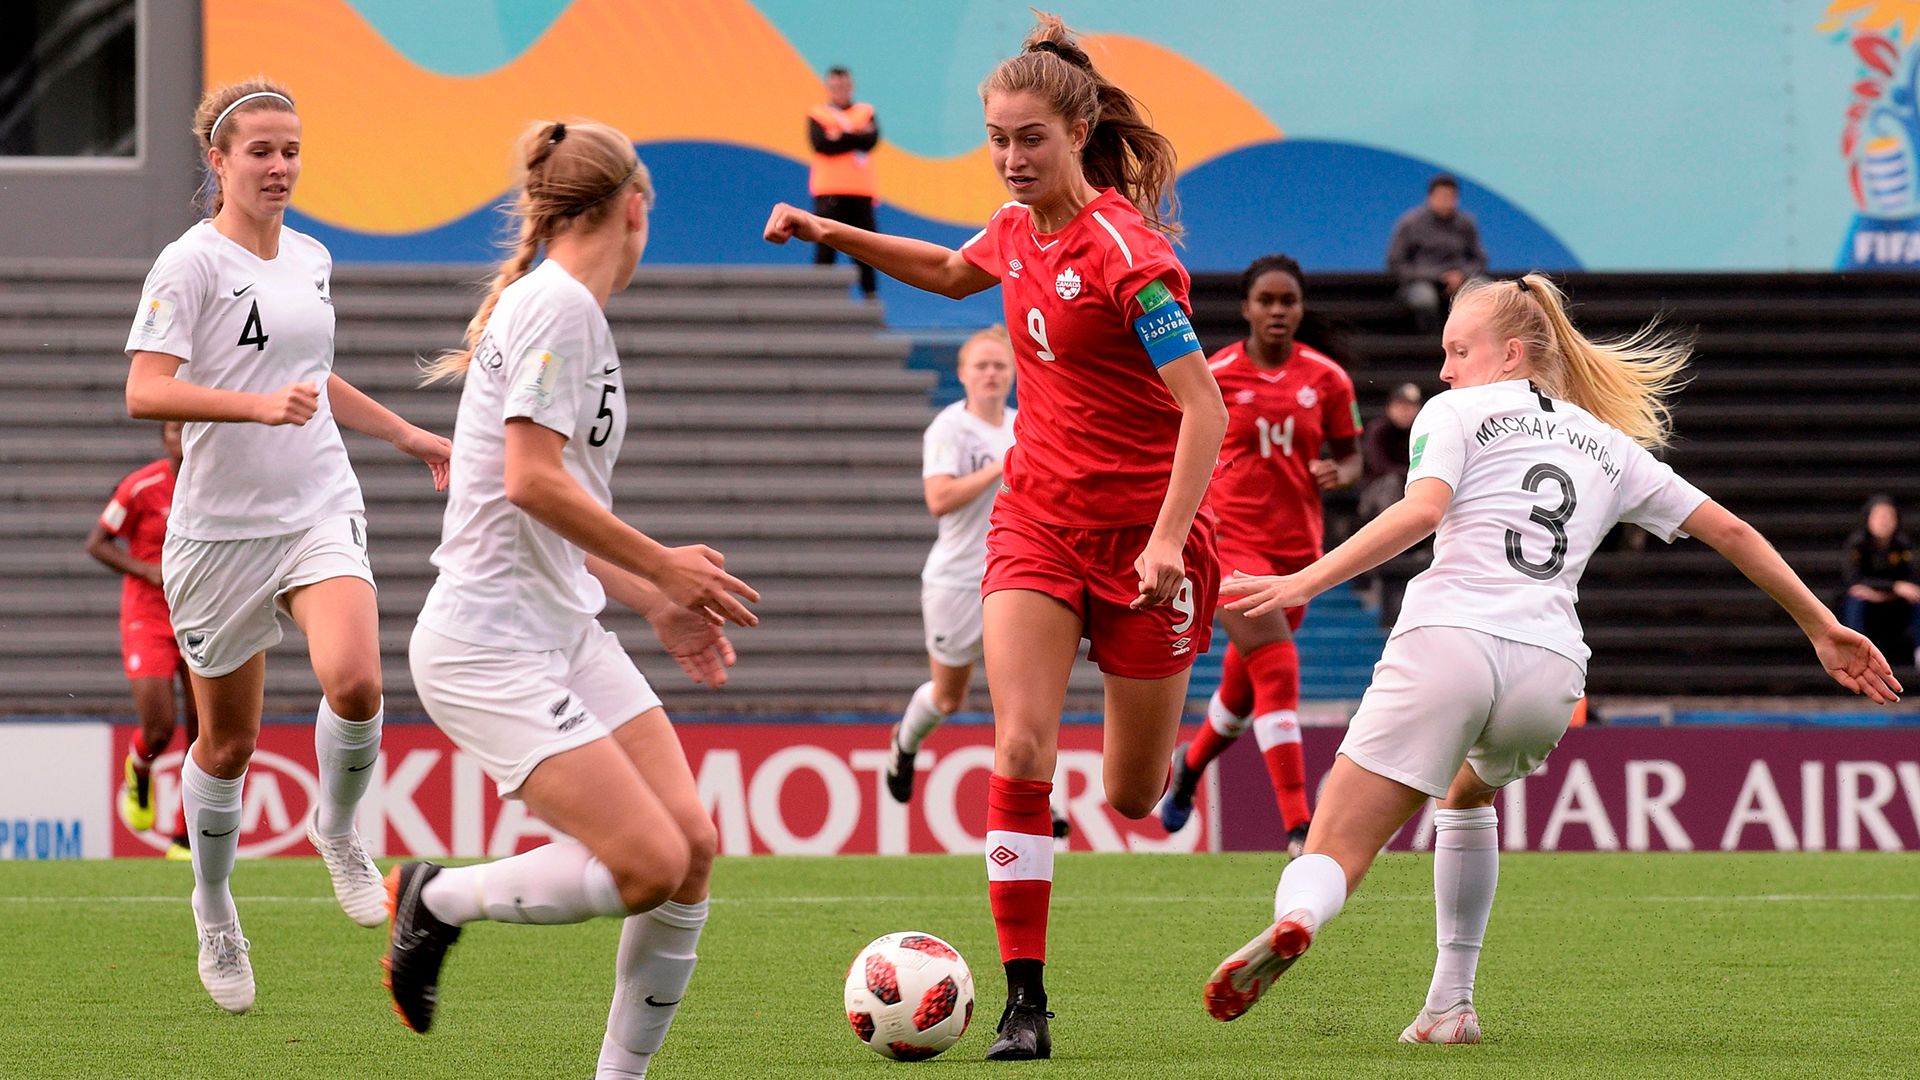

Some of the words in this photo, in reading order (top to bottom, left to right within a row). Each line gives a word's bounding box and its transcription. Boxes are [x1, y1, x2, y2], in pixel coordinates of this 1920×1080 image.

[237, 298, 269, 351] 4
[1027, 307, 1056, 362] 9
[589, 383, 617, 447] 5
[1255, 414, 1295, 459] 14
[1504, 462, 1578, 581] 3
[1172, 576, 1195, 634] 9
[1720, 758, 1920, 851] AIR
